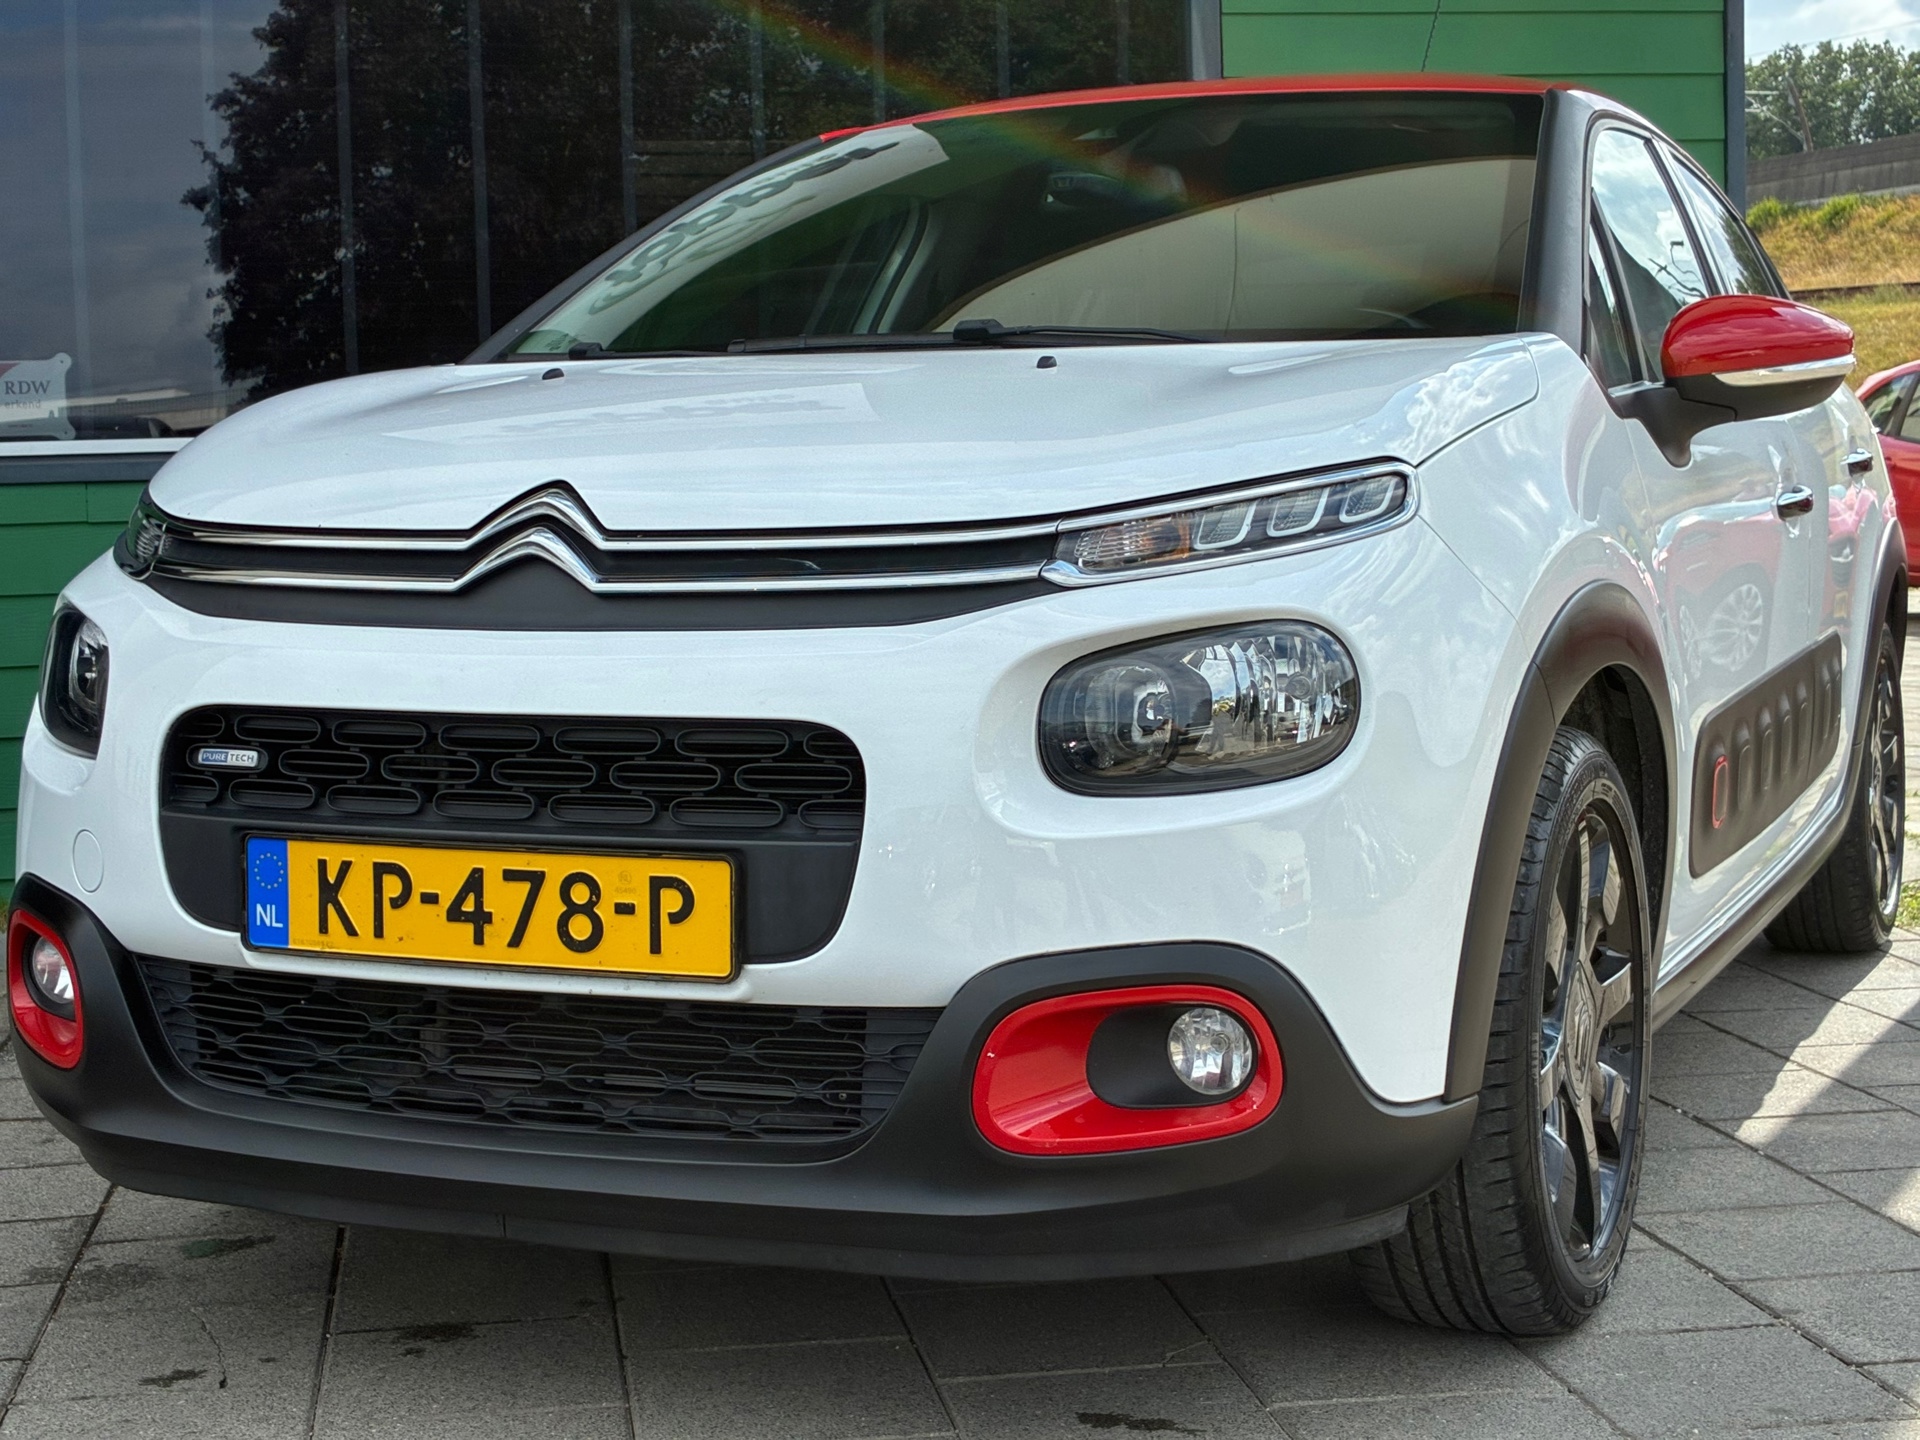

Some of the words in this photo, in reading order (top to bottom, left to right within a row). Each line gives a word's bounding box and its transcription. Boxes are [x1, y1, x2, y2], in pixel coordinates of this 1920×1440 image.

[4, 380, 52, 395] RDW
[4, 399, 42, 409] erkend
[256, 903, 284, 928] NL
[317, 857, 696, 955] KP-478-P
